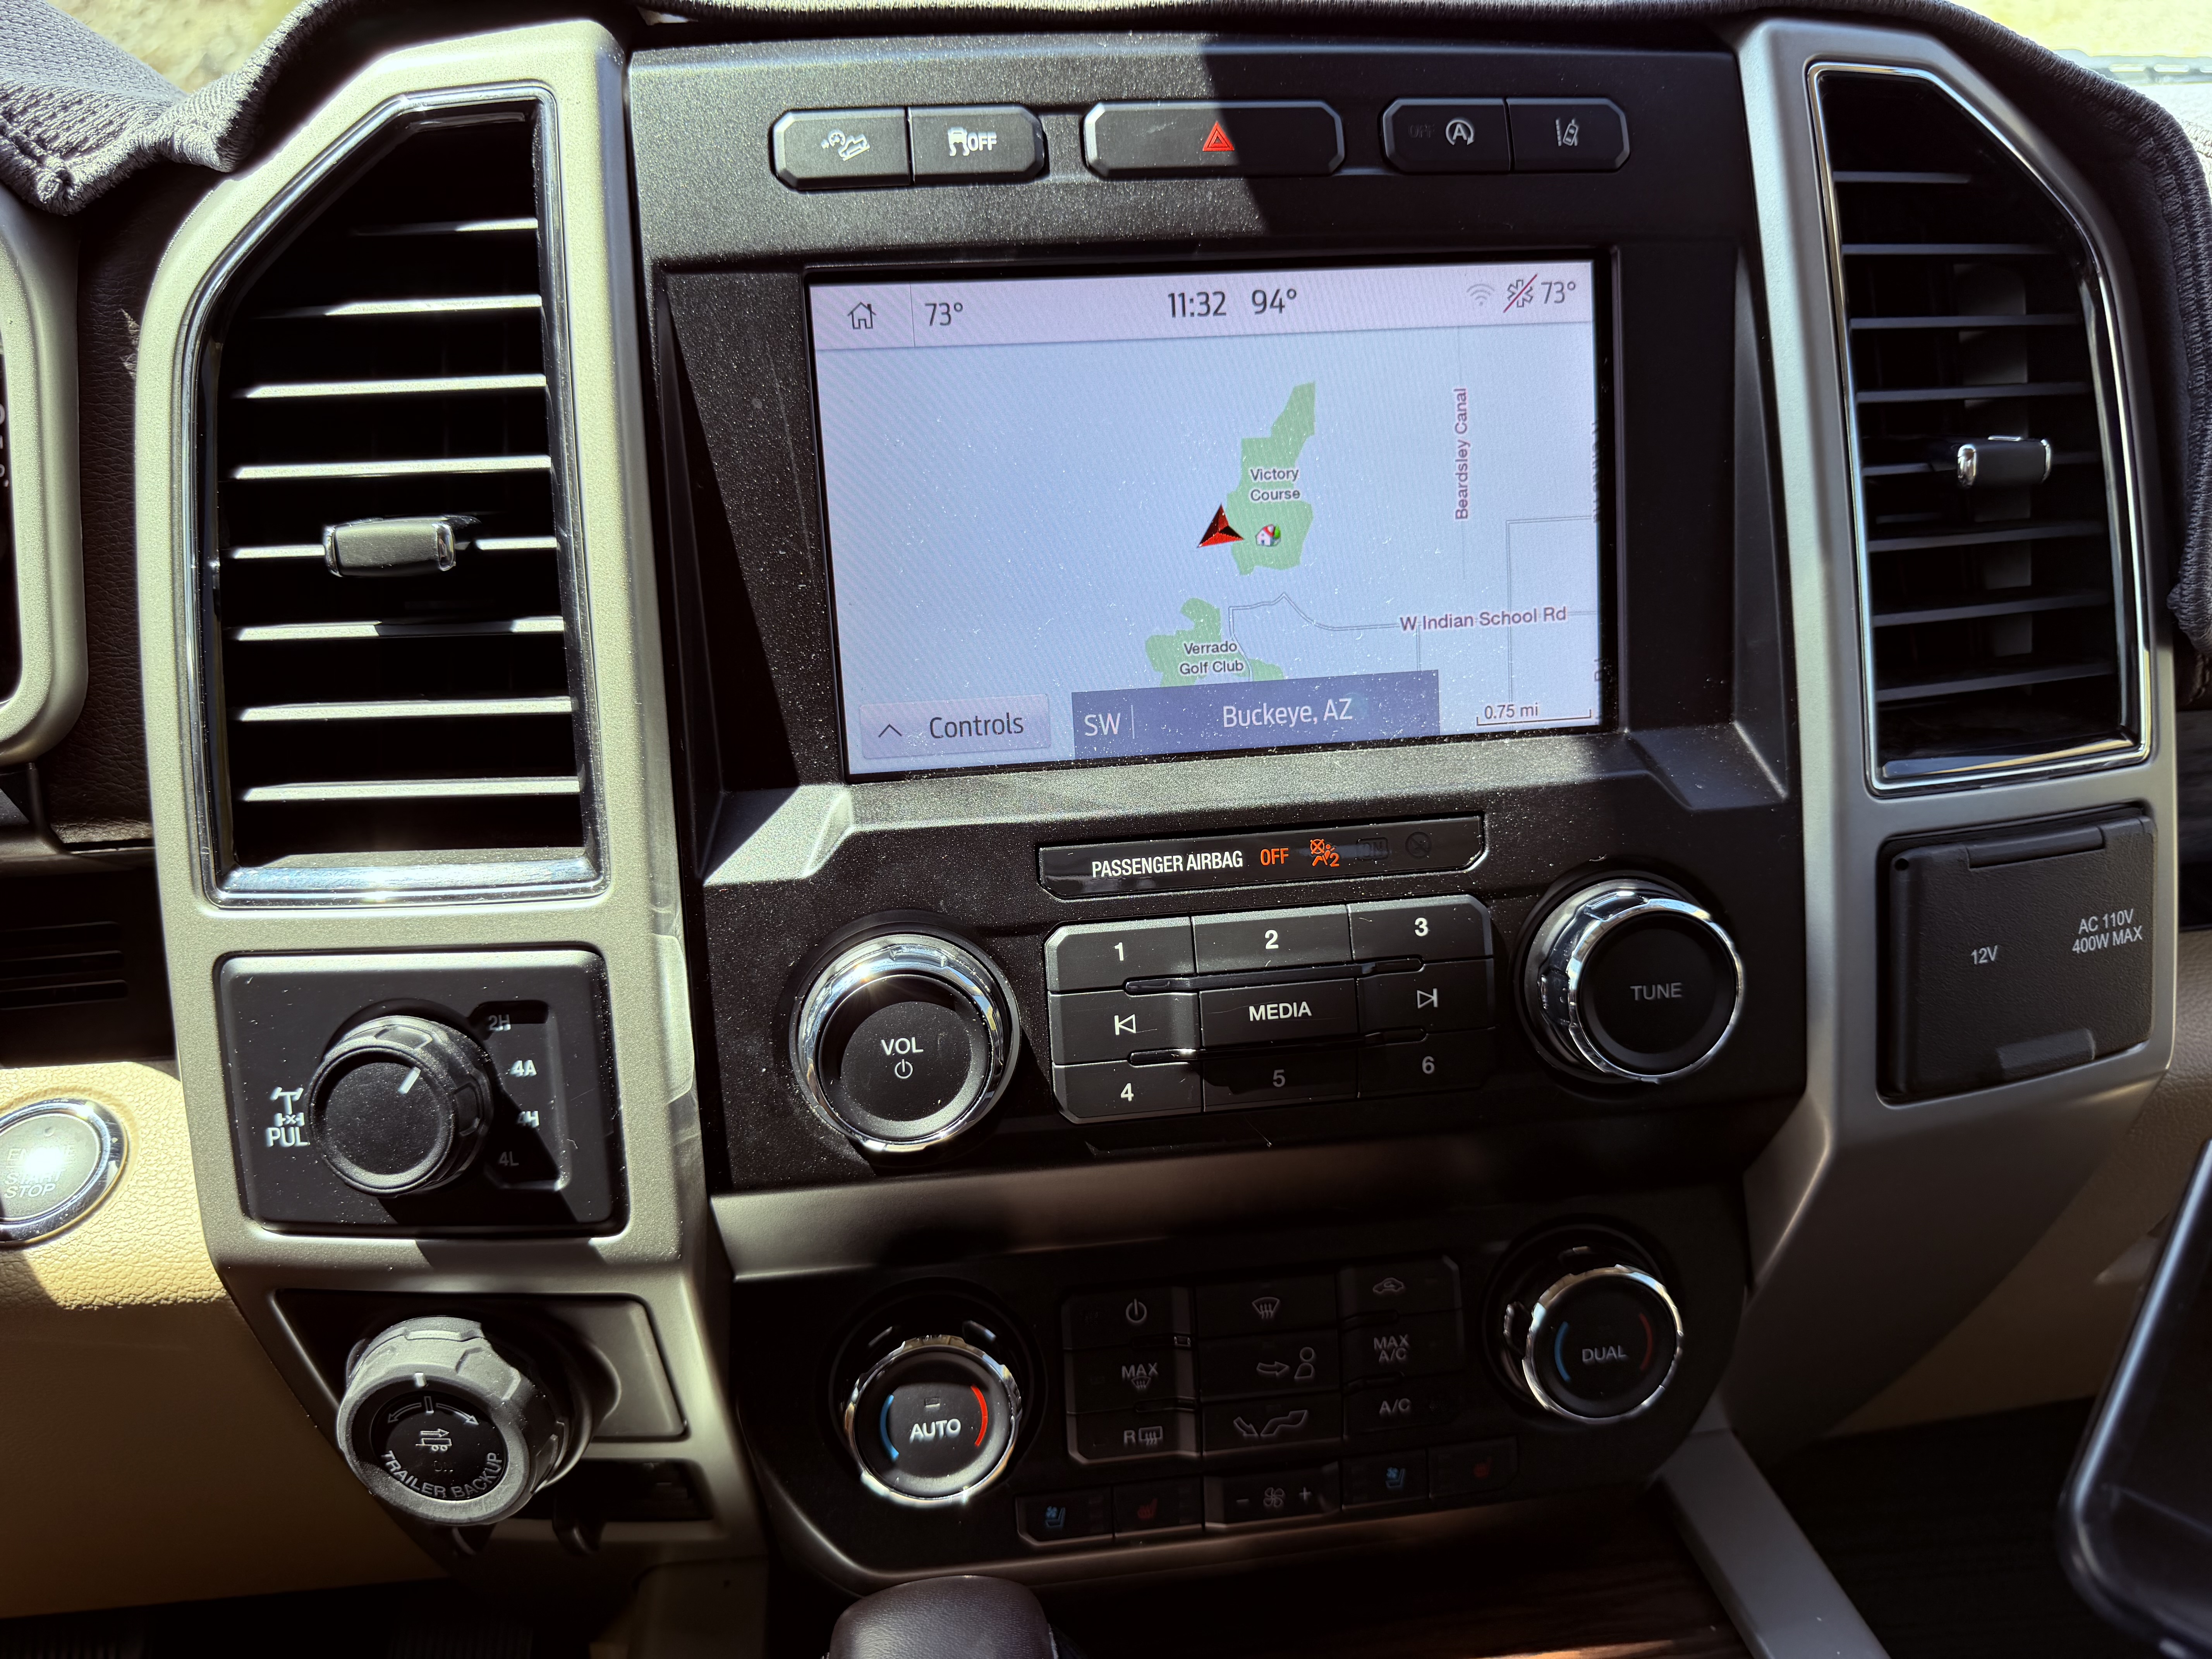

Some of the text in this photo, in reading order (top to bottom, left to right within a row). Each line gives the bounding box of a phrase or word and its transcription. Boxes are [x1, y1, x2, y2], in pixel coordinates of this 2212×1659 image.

[968, 132, 997, 151] OFF
[1541, 281, 1576, 305] 73°
[1168, 289, 1297, 318] 11:32 94°
[924, 302, 963, 327] 73°
[1454, 388, 1470, 520] Beardsley Canal
[1250, 467, 1299, 483] Victory
[1250, 489, 1300, 502] Course
[1400, 607, 1567, 631] W Indian School Rd
[1183, 641, 1238, 655] Verrado
[1179, 660, 1244, 675] Golf Club
[1223, 698, 1353, 728] Buckeye, AZ
[1484, 702, 1539, 720] 0.75 mi
[929, 713, 1024, 739] Controls
[1084, 713, 1120, 737] SW
[1091, 855, 1183, 878] PASSENGER
[1186, 850, 1243, 871] AIRBAG
[1260, 847, 1290, 866] OFF
[1414, 917, 1429, 937] 3
[2078, 908, 2135, 934] AC 110V
[1264, 930, 1279, 949] 2
[2072, 925, 2143, 954] 400W MAX
[1114, 942, 1125, 962] 1
[1971, 945, 1998, 964] 12V
[1630, 982, 1683, 1001] TUNE
[1249, 1001, 1312, 1022] MEDIA
[488, 1014, 511, 1031] 2H
[881, 1037, 924, 1055] VOL
[510, 1059, 537, 1077] 4A
[1421, 1056, 1435, 1075] 6
[1272, 1070, 1286, 1088] 5
[1120, 1083, 1135, 1102] 4
[265, 1127, 311, 1147] PUL
[498, 1151, 519, 1166] 4L
[4, 1183, 56, 1199] STOP
[1373, 1334, 1410, 1352] MAX
[1379, 1347, 1408, 1362] A/C
[1582, 1345, 1628, 1364] DUAL
[1121, 1362, 1159, 1380] MAX
[1379, 1398, 1412, 1415] A/C
[910, 1418, 961, 1441] AUTO
[381, 1450, 503, 1497] TRAILER BACKUP
